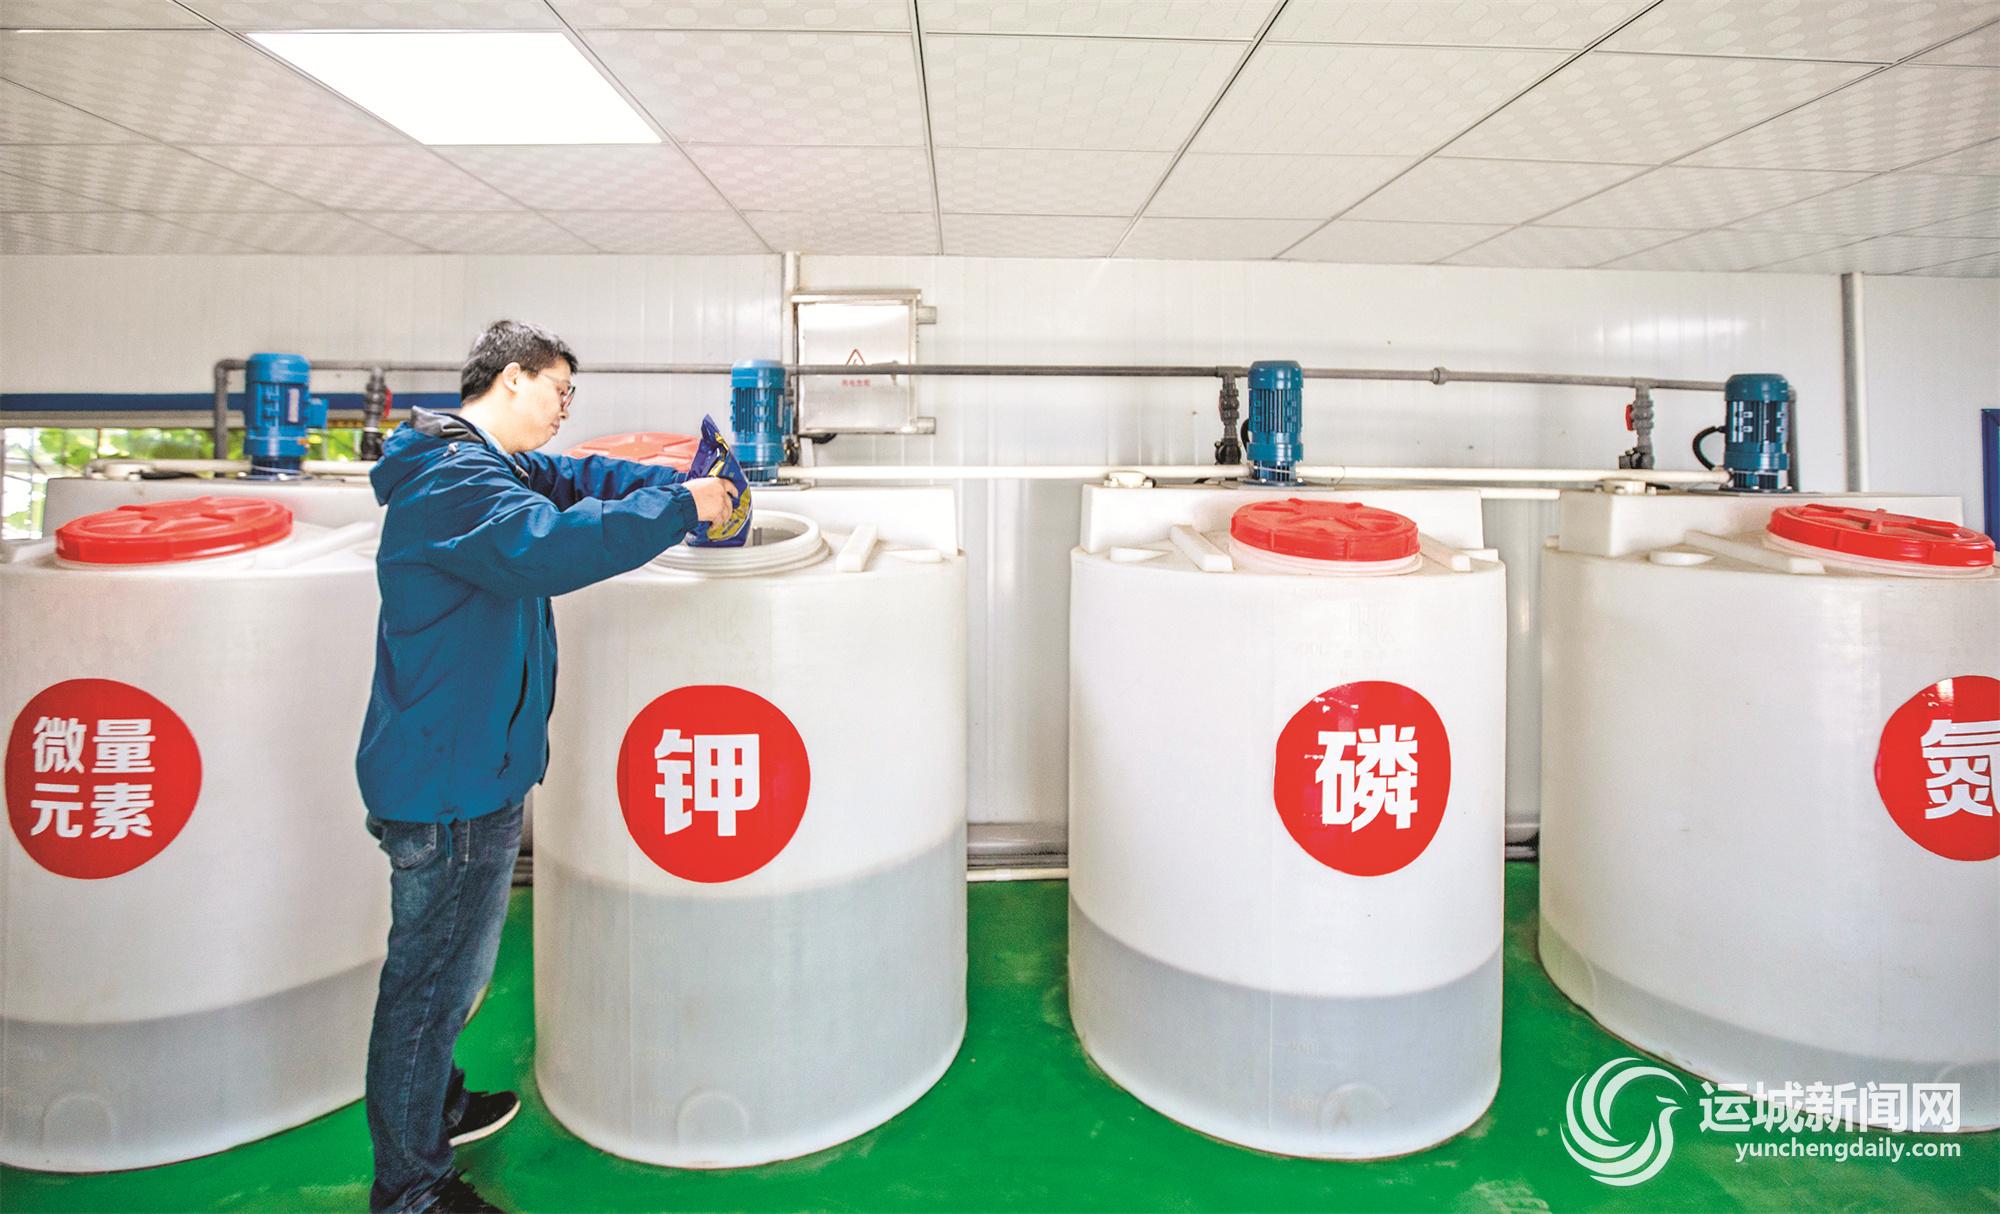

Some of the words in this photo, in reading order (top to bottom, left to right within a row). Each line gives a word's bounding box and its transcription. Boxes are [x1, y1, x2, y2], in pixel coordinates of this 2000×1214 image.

[32, 715, 156, 774] 微量
[654, 728, 761, 837] 钾
[1315, 724, 1418, 833] 磷
[1920, 719, 2000, 820] 氮
[30, 782, 155, 840] 元素
